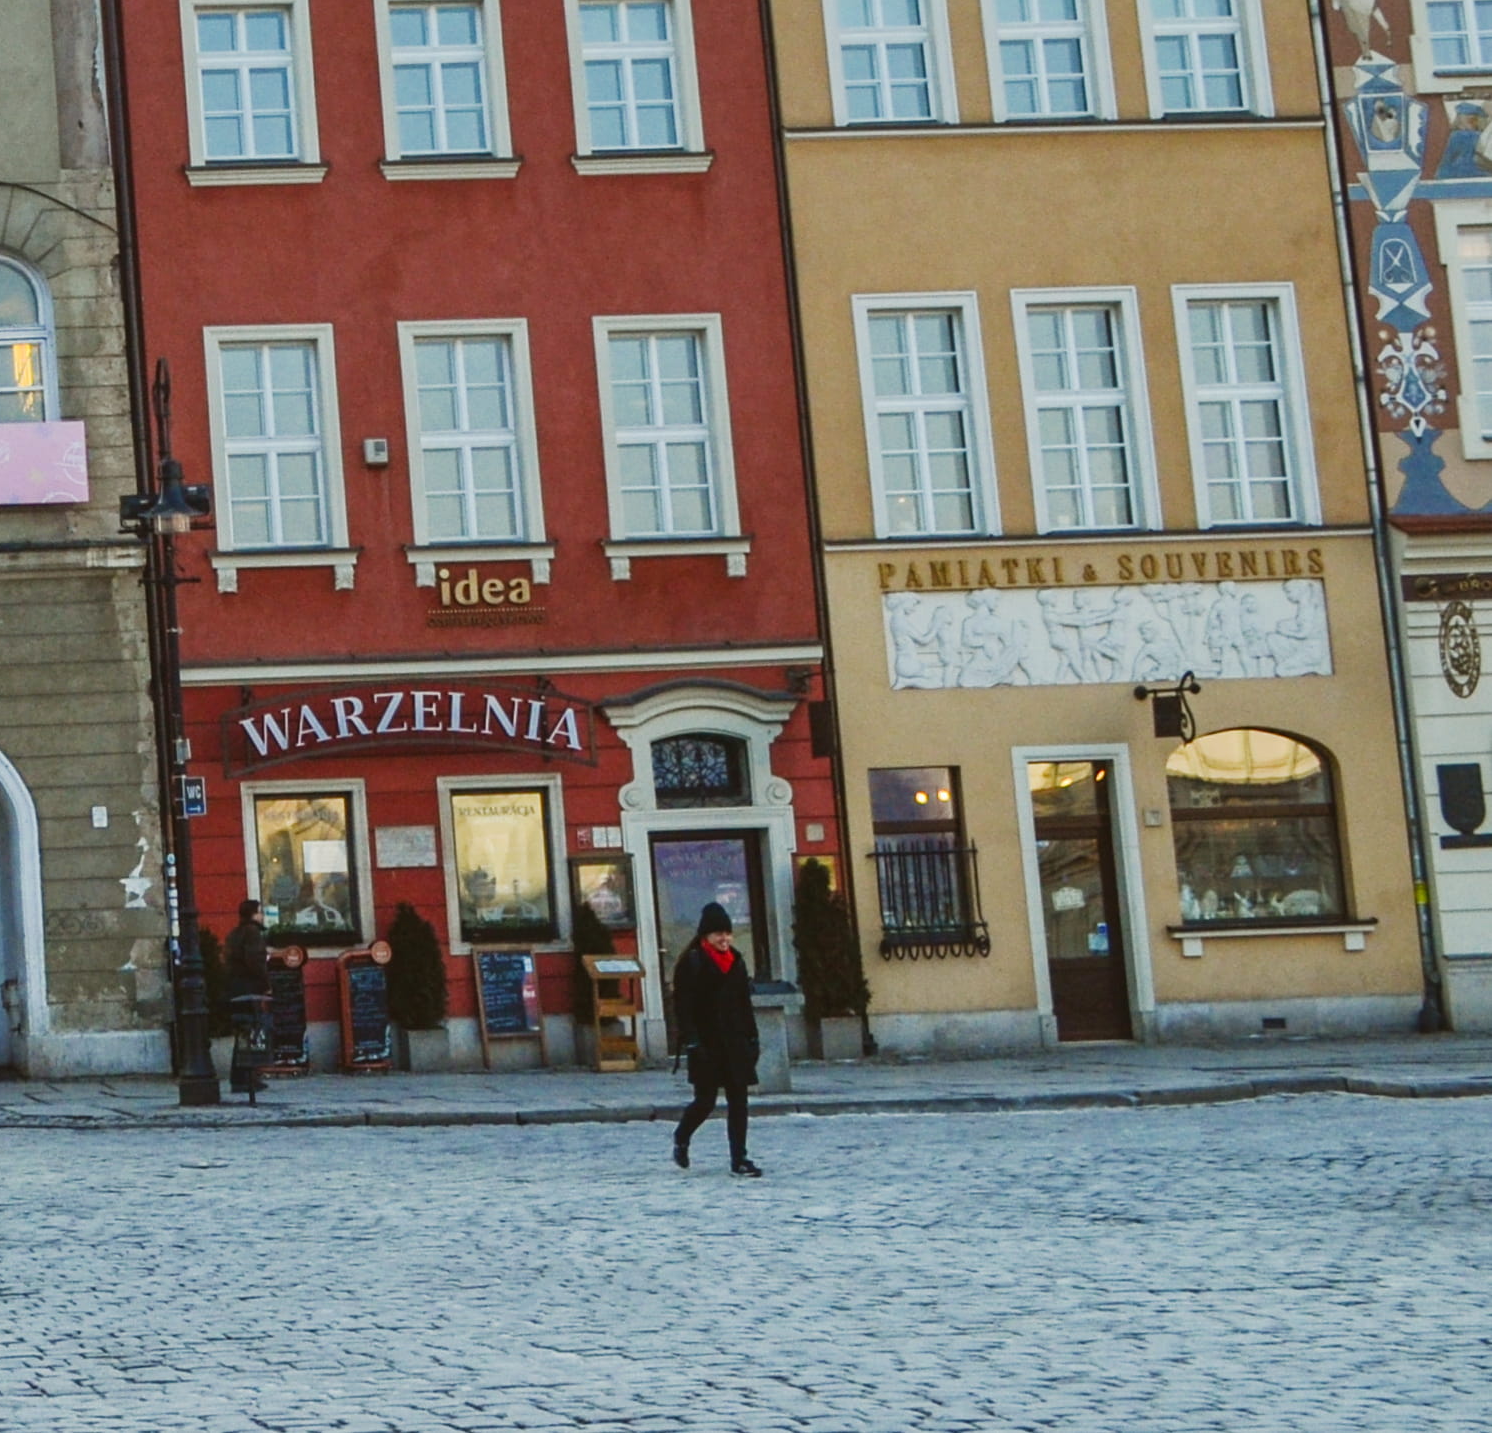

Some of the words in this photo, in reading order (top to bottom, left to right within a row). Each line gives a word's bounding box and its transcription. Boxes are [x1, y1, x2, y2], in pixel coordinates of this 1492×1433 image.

[1082, 563, 1098, 583] &
[1118, 548, 1325, 582] SOUVENIRS
[438, 568, 531, 606] idea
[239, 690, 583, 757] WARZELNIA
[186, 785, 202, 800] WC
